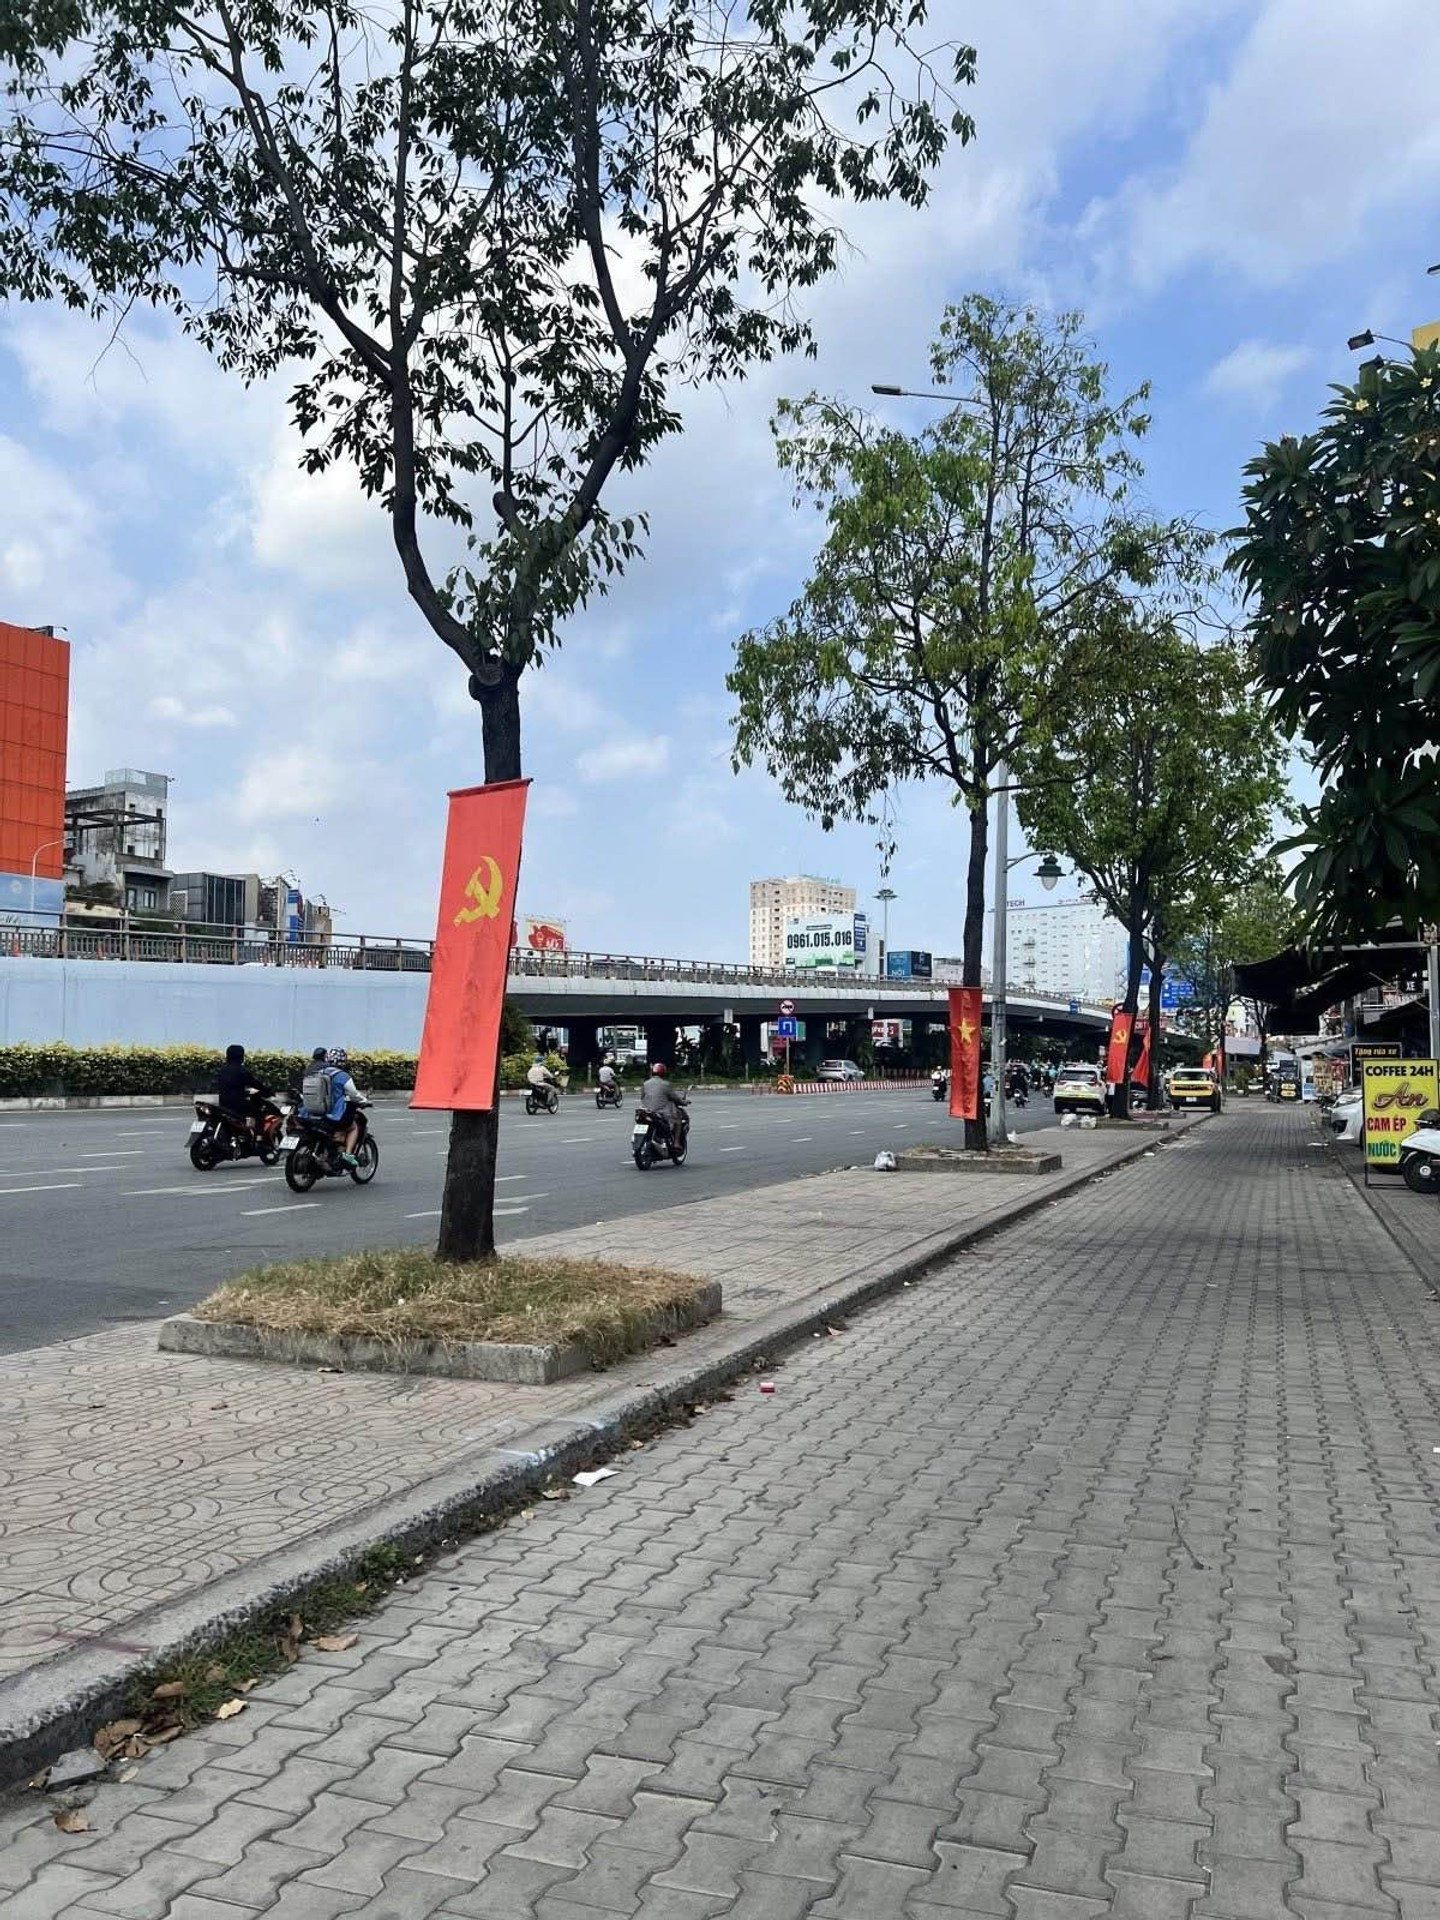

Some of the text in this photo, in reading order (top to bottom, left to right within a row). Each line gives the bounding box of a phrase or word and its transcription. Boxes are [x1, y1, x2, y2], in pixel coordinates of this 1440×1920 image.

[1366, 1066, 1434, 1077] COFFEE 24H
[1367, 1114, 1407, 1132] CAM ÉP
